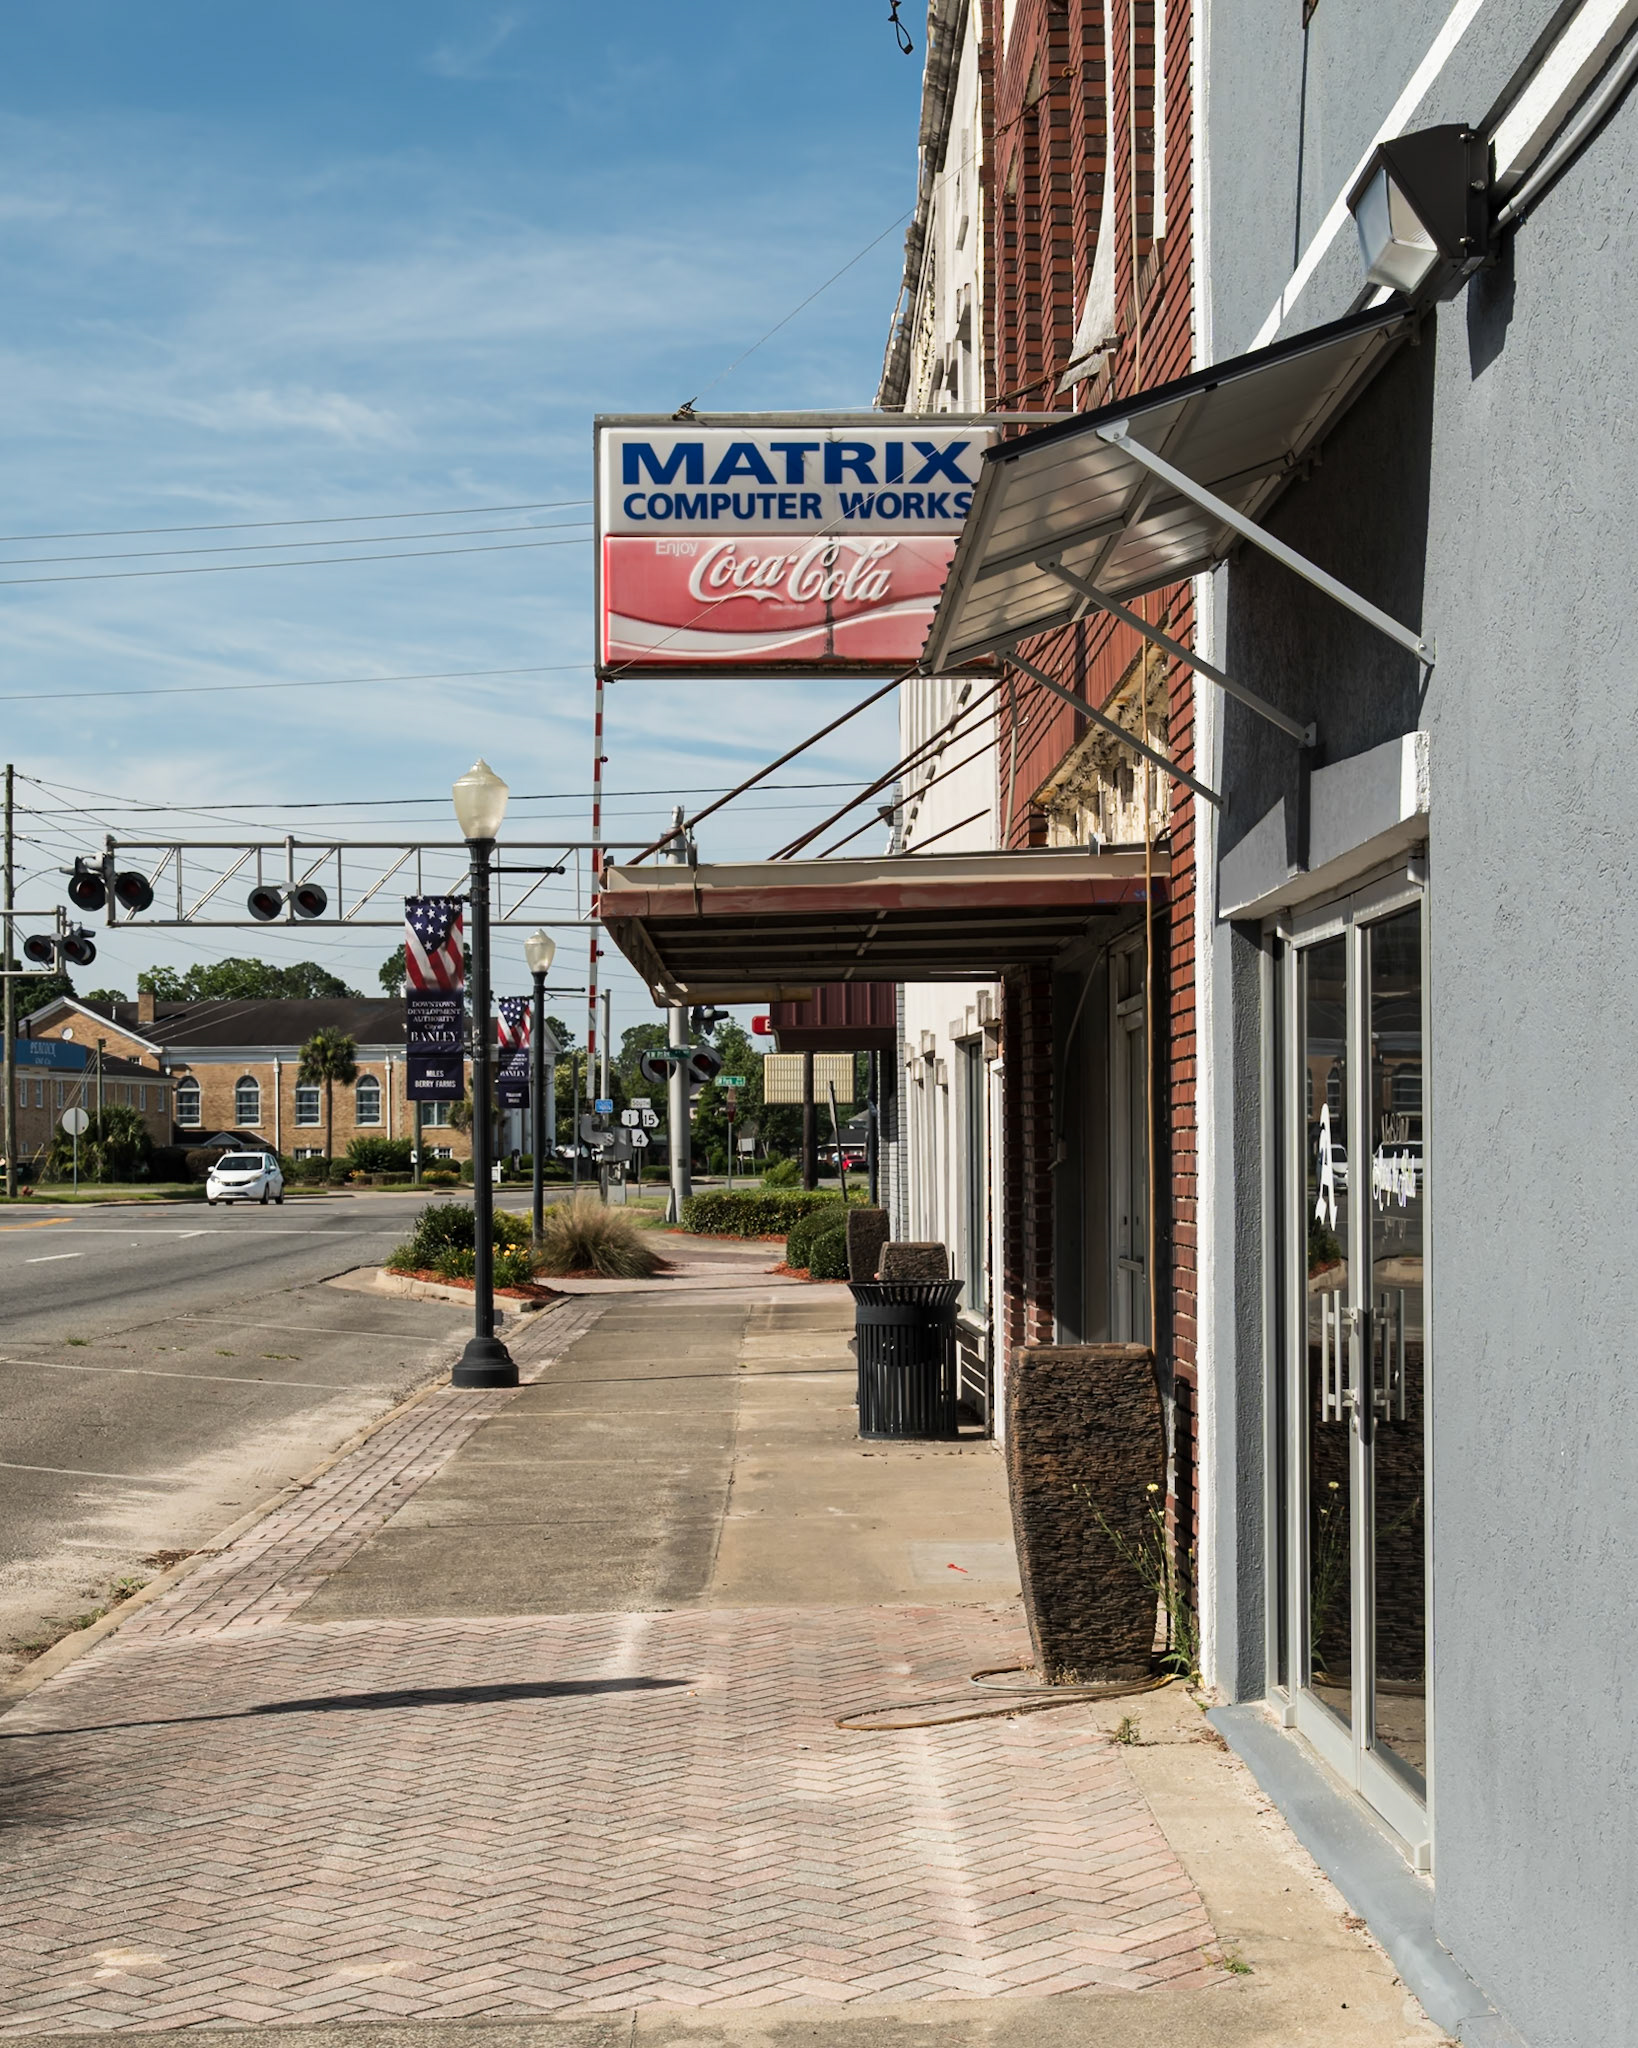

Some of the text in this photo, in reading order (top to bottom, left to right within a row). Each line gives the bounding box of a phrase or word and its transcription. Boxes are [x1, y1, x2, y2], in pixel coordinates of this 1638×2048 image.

[622, 442, 972, 484] MATRIX
[623, 491, 972, 520] COMPUTER WORKS
[655, 540, 698, 557] Enjoy
[688, 538, 900, 604] Coca-Cola
[411, 1031, 458, 1042] BAXLEY
[414, 1080, 456, 1088] BERRY FARMS
[644, 1114, 655, 1126] 15
[636, 1134, 643, 1145] 4
